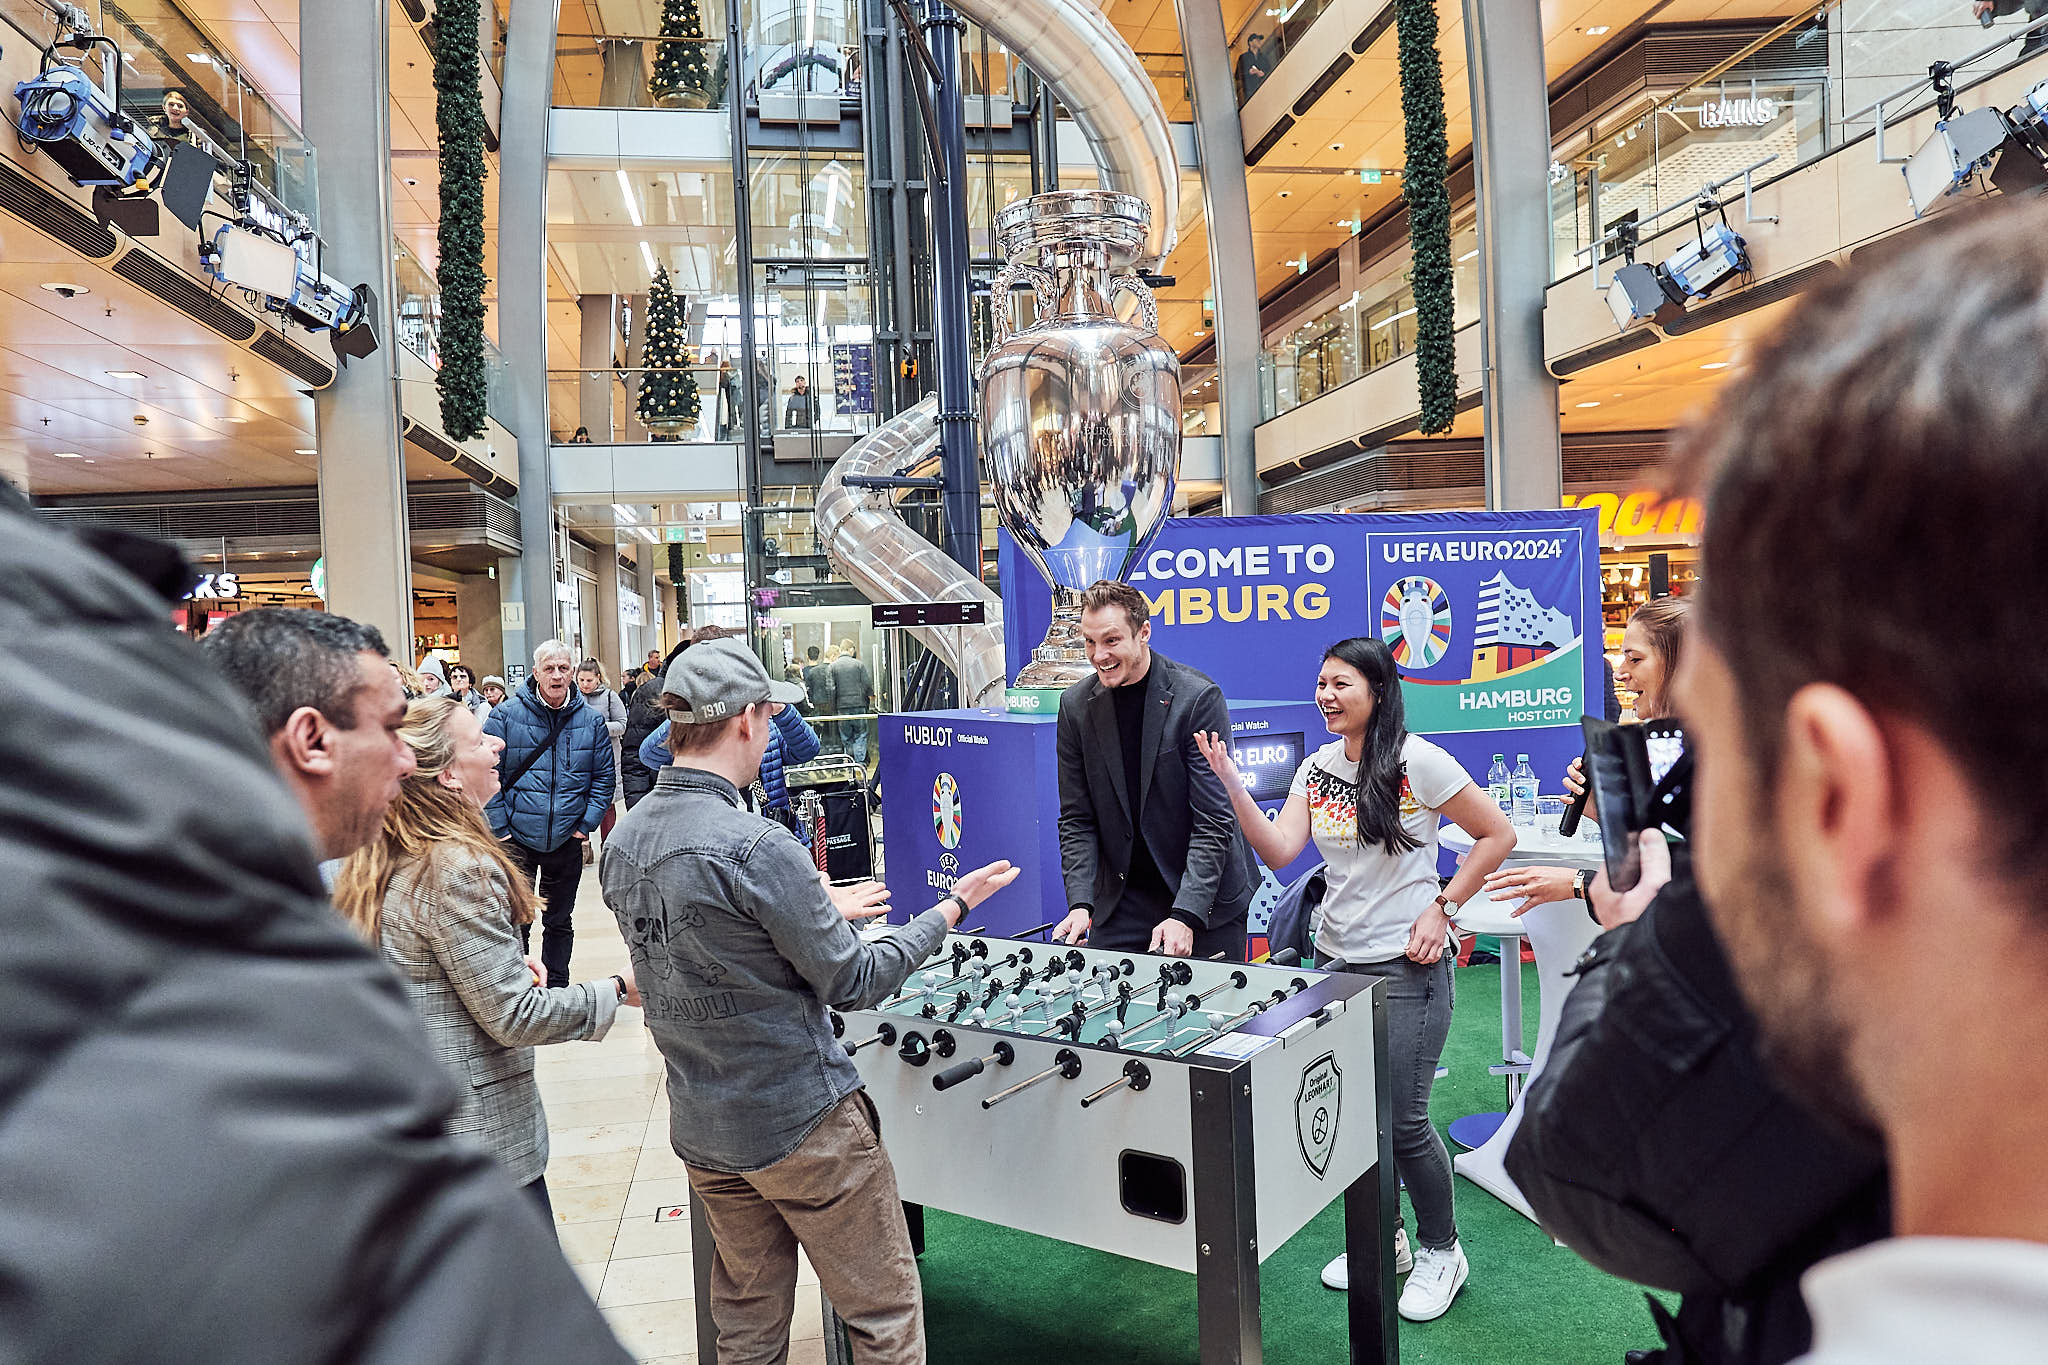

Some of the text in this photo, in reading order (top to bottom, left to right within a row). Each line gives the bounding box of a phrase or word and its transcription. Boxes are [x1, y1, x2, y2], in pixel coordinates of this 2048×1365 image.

[1700, 98, 1778, 127] RAINS
[1277, 543, 1335, 574] TO
[701, 701, 726, 718] 1910
[1460, 687, 1572, 710] HAMBURG
[1245, 720, 1269, 730] Watch
[1508, 708, 1571, 722] HOST CITY
[904, 724, 989, 747] HUBLOT Official Watch
[1246, 745, 1288, 766] EURO
[940, 855, 958, 873] UEFA
[657, 991, 738, 1021] PAULI
[1309, 1068, 1328, 1088] Original
[1304, 1077, 1333, 1103] LEONHART
